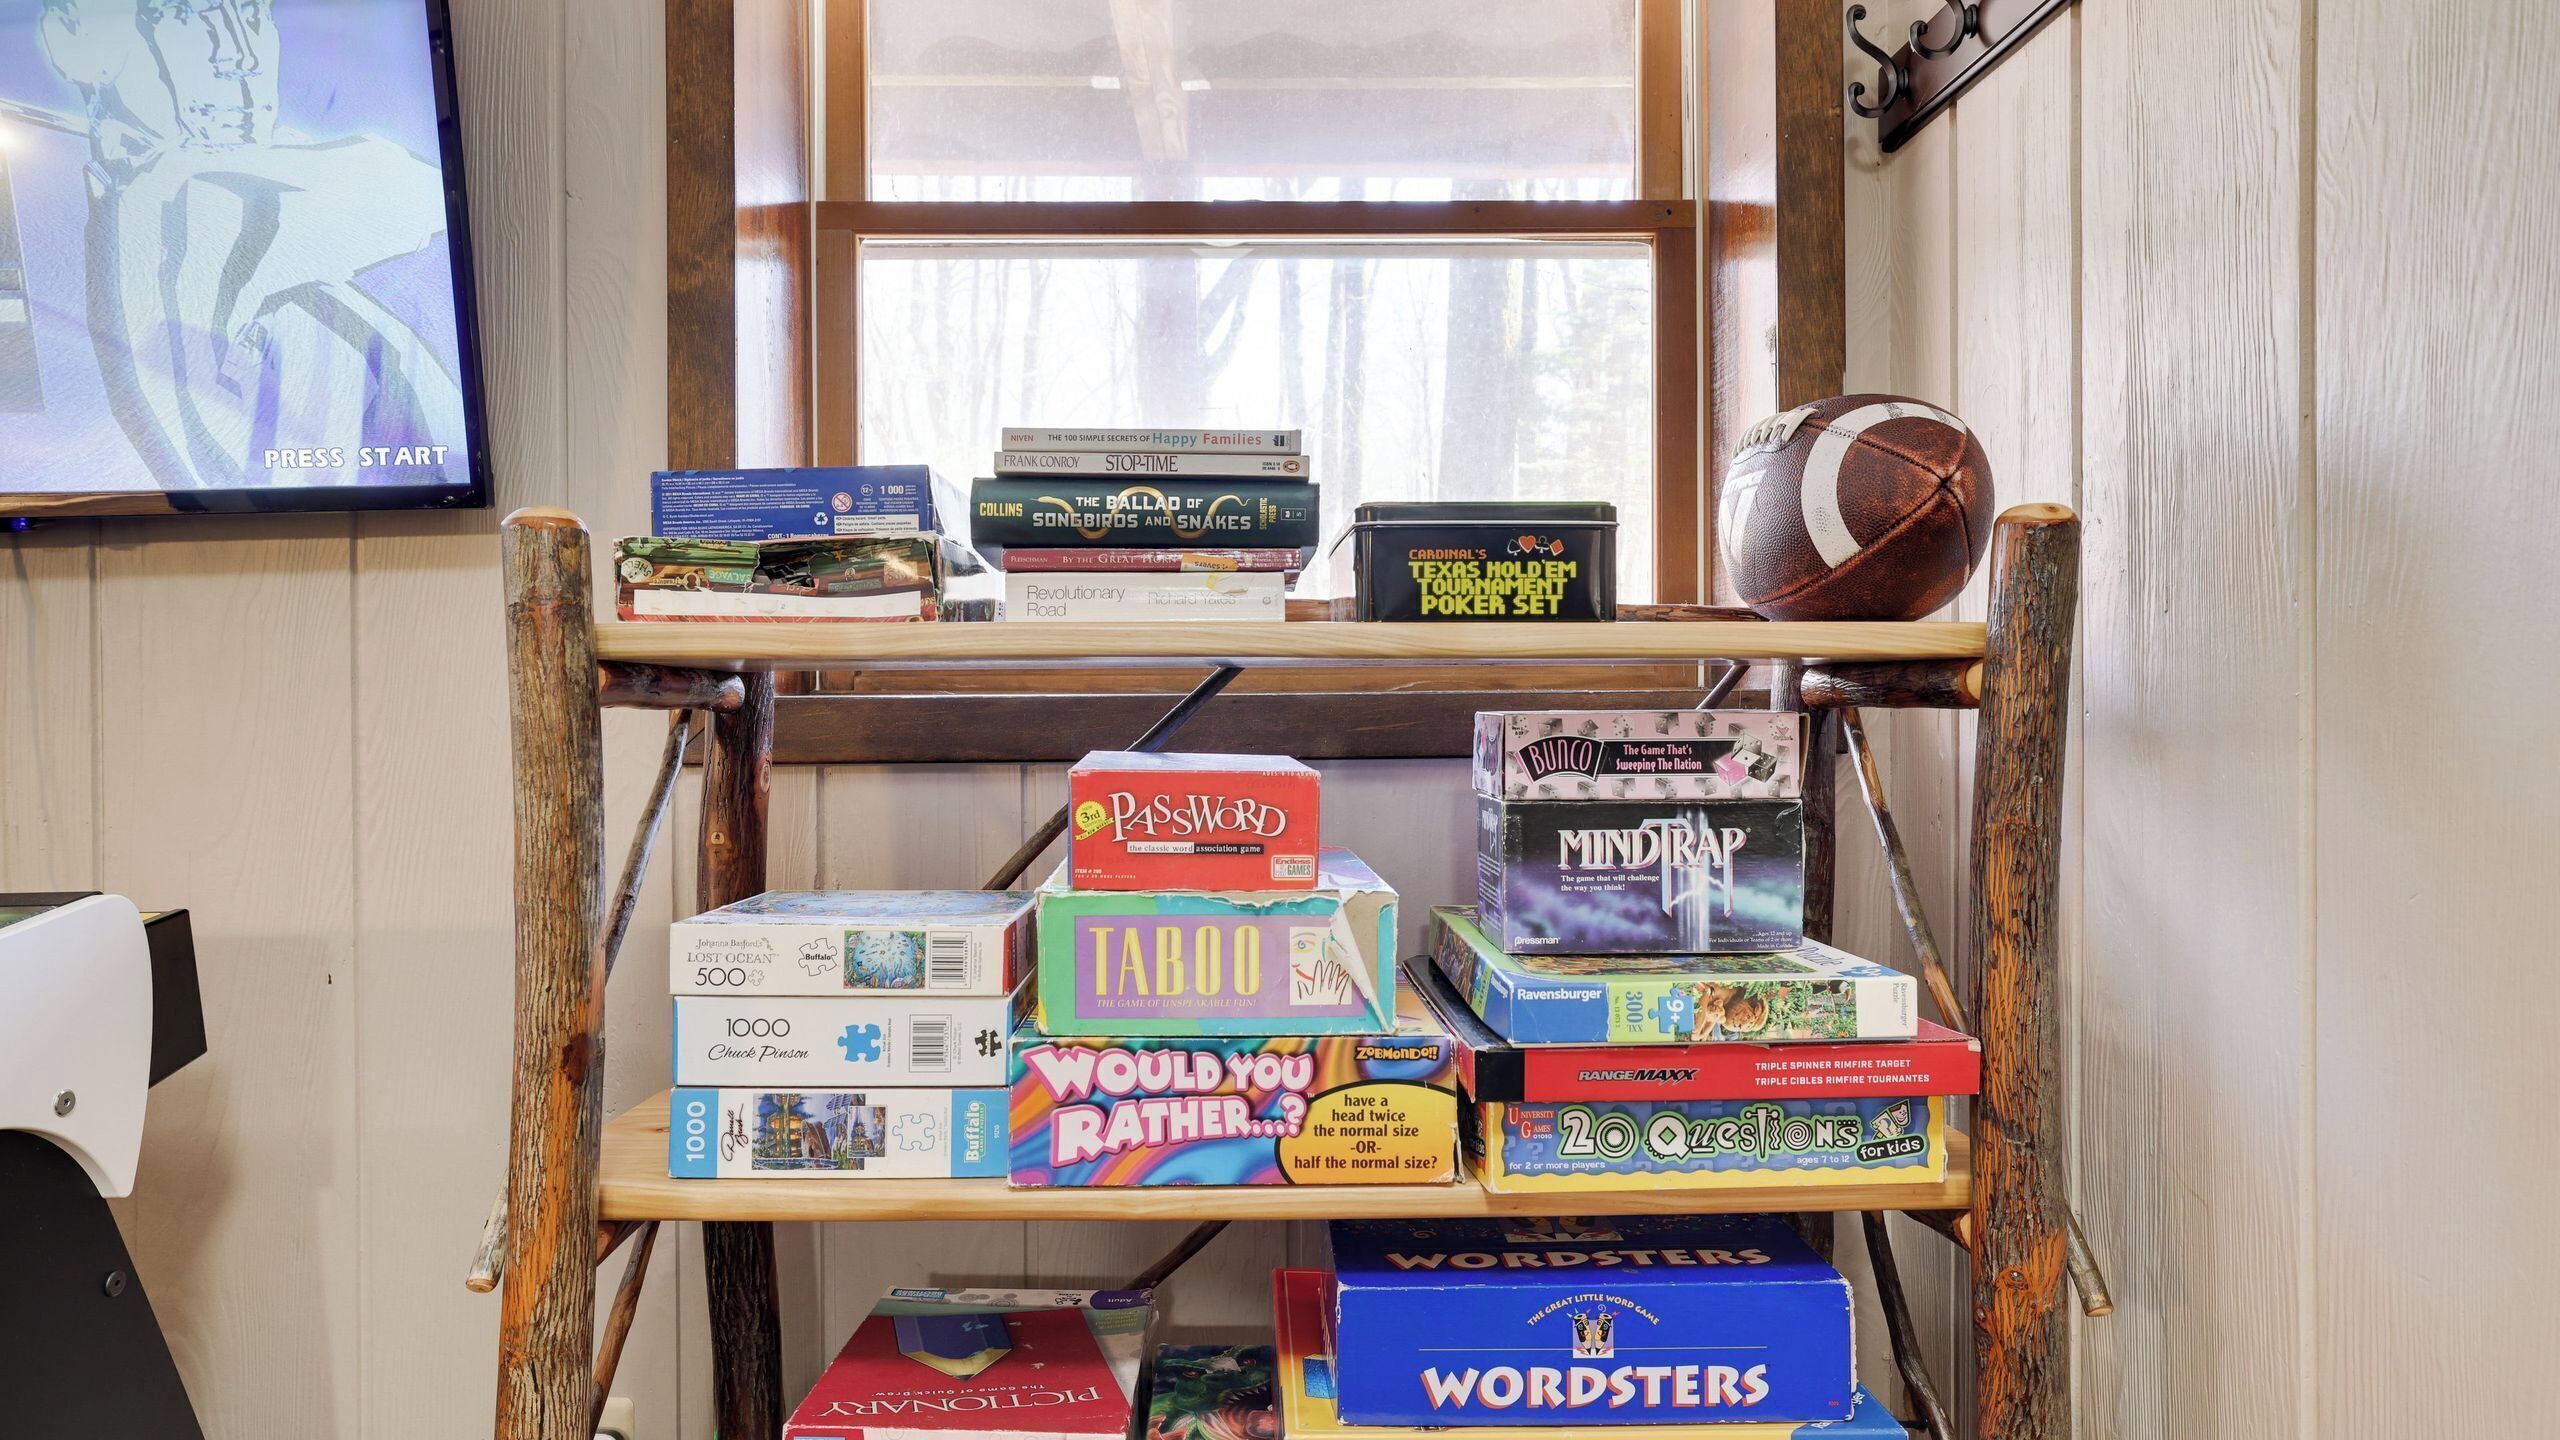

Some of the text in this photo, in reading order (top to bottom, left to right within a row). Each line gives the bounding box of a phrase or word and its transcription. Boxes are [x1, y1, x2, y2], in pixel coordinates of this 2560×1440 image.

[1152, 433, 1197, 447] Happy
[1203, 433, 1262, 445] Families
[264, 446, 447, 468] PRESS START
[1004, 455, 1178, 472] FRANK CONROY STOP-TIME
[888, 485, 904, 495] 000
[979, 502, 1023, 517] COLLINS
[1076, 496, 1203, 510] THE BALLAD OF
[1033, 512, 1251, 530] SONGBIRDS AND SNAKES
[1259, 497, 1268, 530] SCHOLASTIC
[1268, 504, 1277, 523] PRESS
[1408, 548, 1487, 560] CARDINAL'S
[1408, 559, 1577, 579] TEXAS HOLD'EM
[1027, 585, 1125, 602] Revolutionary
[1416, 578, 1568, 595] TOURNAMENT
[1148, 591, 1236, 605] Richard Yates
[1421, 595, 1563, 615] POKER SET
[1027, 603, 1067, 617] Road
[1528, 740, 1593, 775] BUNCO
[1623, 744, 1692, 756] The Game That's
[1616, 758, 1702, 772] Sweeping The Nation
[1080, 809, 1100, 823] 3rd
[1108, 792, 1286, 842] PASSWORD
[1144, 844, 1169, 852] classic
[1195, 844, 1238, 852] association
[1240, 846, 1260, 854] game
[1287, 865, 1311, 876] GAMES
[1558, 818, 1747, 918] MINDTRAP
[1576, 875, 1595, 883] game
[1627, 874, 1659, 882] challenge
[1561, 884, 1572, 892] the
[1604, 883, 1625, 891] think!
[696, 938, 729, 949] Johanna
[687, 952, 772, 964] LOST OCEAN
[1088, 925, 1261, 996] TABOO
[695, 967, 746, 986] 500
[1096, 998, 1257, 1008] THE GAME OF UNSPEAKABLE FUN!
[1517, 987, 1602, 1002] Ravensburger
[1625, 991, 1644, 1023] 300
[1666, 1000, 1684, 1023] 9+
[1900, 982, 1908, 1026] Ravensburger
[726, 1018, 790, 1037] 1000
[1627, 1024, 1643, 1033] XXL
[708, 1043, 809, 1063] Chuck Pinson
[1355, 1046, 1439, 1061] ZOBMONDO!!
[1028, 1048, 1313, 1099] WOULD YOU
[1755, 1059, 1911, 1071] TRIPLE SPINNER RIMFIRE TARGET
[1578, 1069, 1699, 1085] RANGEMAXX
[1755, 1074, 1929, 1086] TRIPLE CIBLES RIMFIRE TOURNANTES
[1344, 1094, 1388, 1107] have a
[1331, 1109, 1406, 1122] head twice
[1508, 1107, 1554, 1125] UNIVERSITY
[686, 1101, 706, 1162] 1000
[965, 1102, 980, 1161] Buffalo
[1055, 1094, 1305, 1165] RATHER...?
[1313, 1124, 1419, 1137] the normal size
[1521, 1121, 1551, 1138] GAMES
[1560, 1109, 1636, 1159] 20
[1350, 1141, 1382, 1154] -OR-
[1860, 1138, 1921, 1161] for kids
[1294, 1156, 1438, 1169] half the normal size?
[1509, 1161, 1523, 1170] for
[1525, 1161, 1531, 1170] 2
[1571, 1161, 1605, 1171] players
[1797, 1155, 1849, 1165] ages 7 to 12
[1385, 1247, 1775, 1270] WORDSTERS
[1527, 1293, 1660, 1326] THE GREAT LITTLE WORD GAME
[1422, 1364, 1771, 1408] WORDSTERS
[819, 1386, 1103, 1417] PICTIONARY
